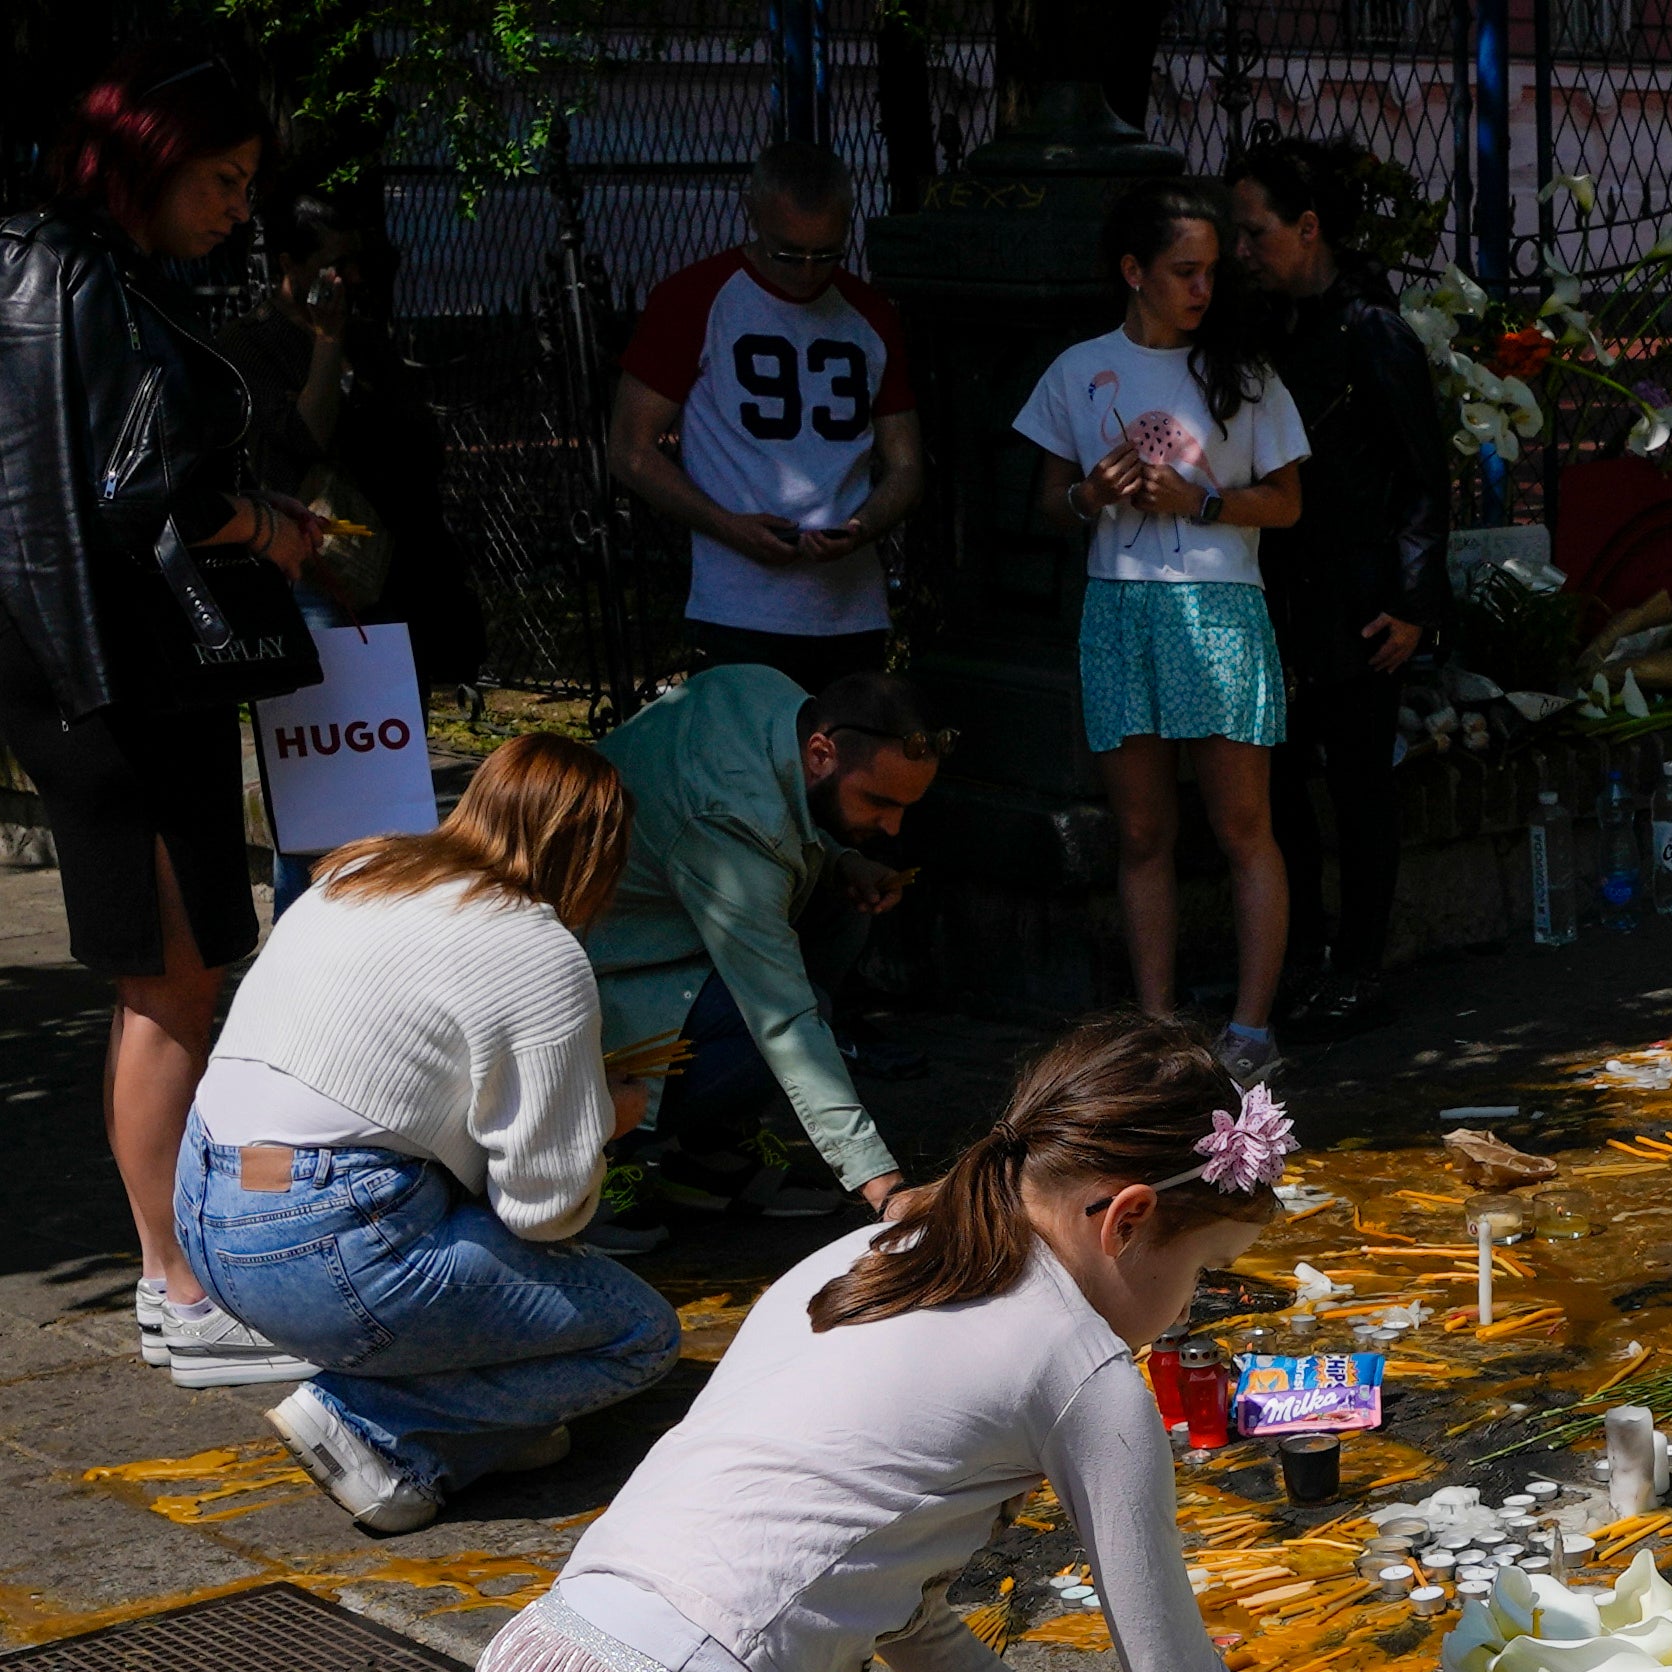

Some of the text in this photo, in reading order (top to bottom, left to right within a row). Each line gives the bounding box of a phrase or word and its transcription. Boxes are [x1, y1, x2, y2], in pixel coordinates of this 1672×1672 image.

[732, 332, 870, 442] 93
[275, 718, 411, 759] HUGO
[1260, 1388, 1341, 1424] Milka
